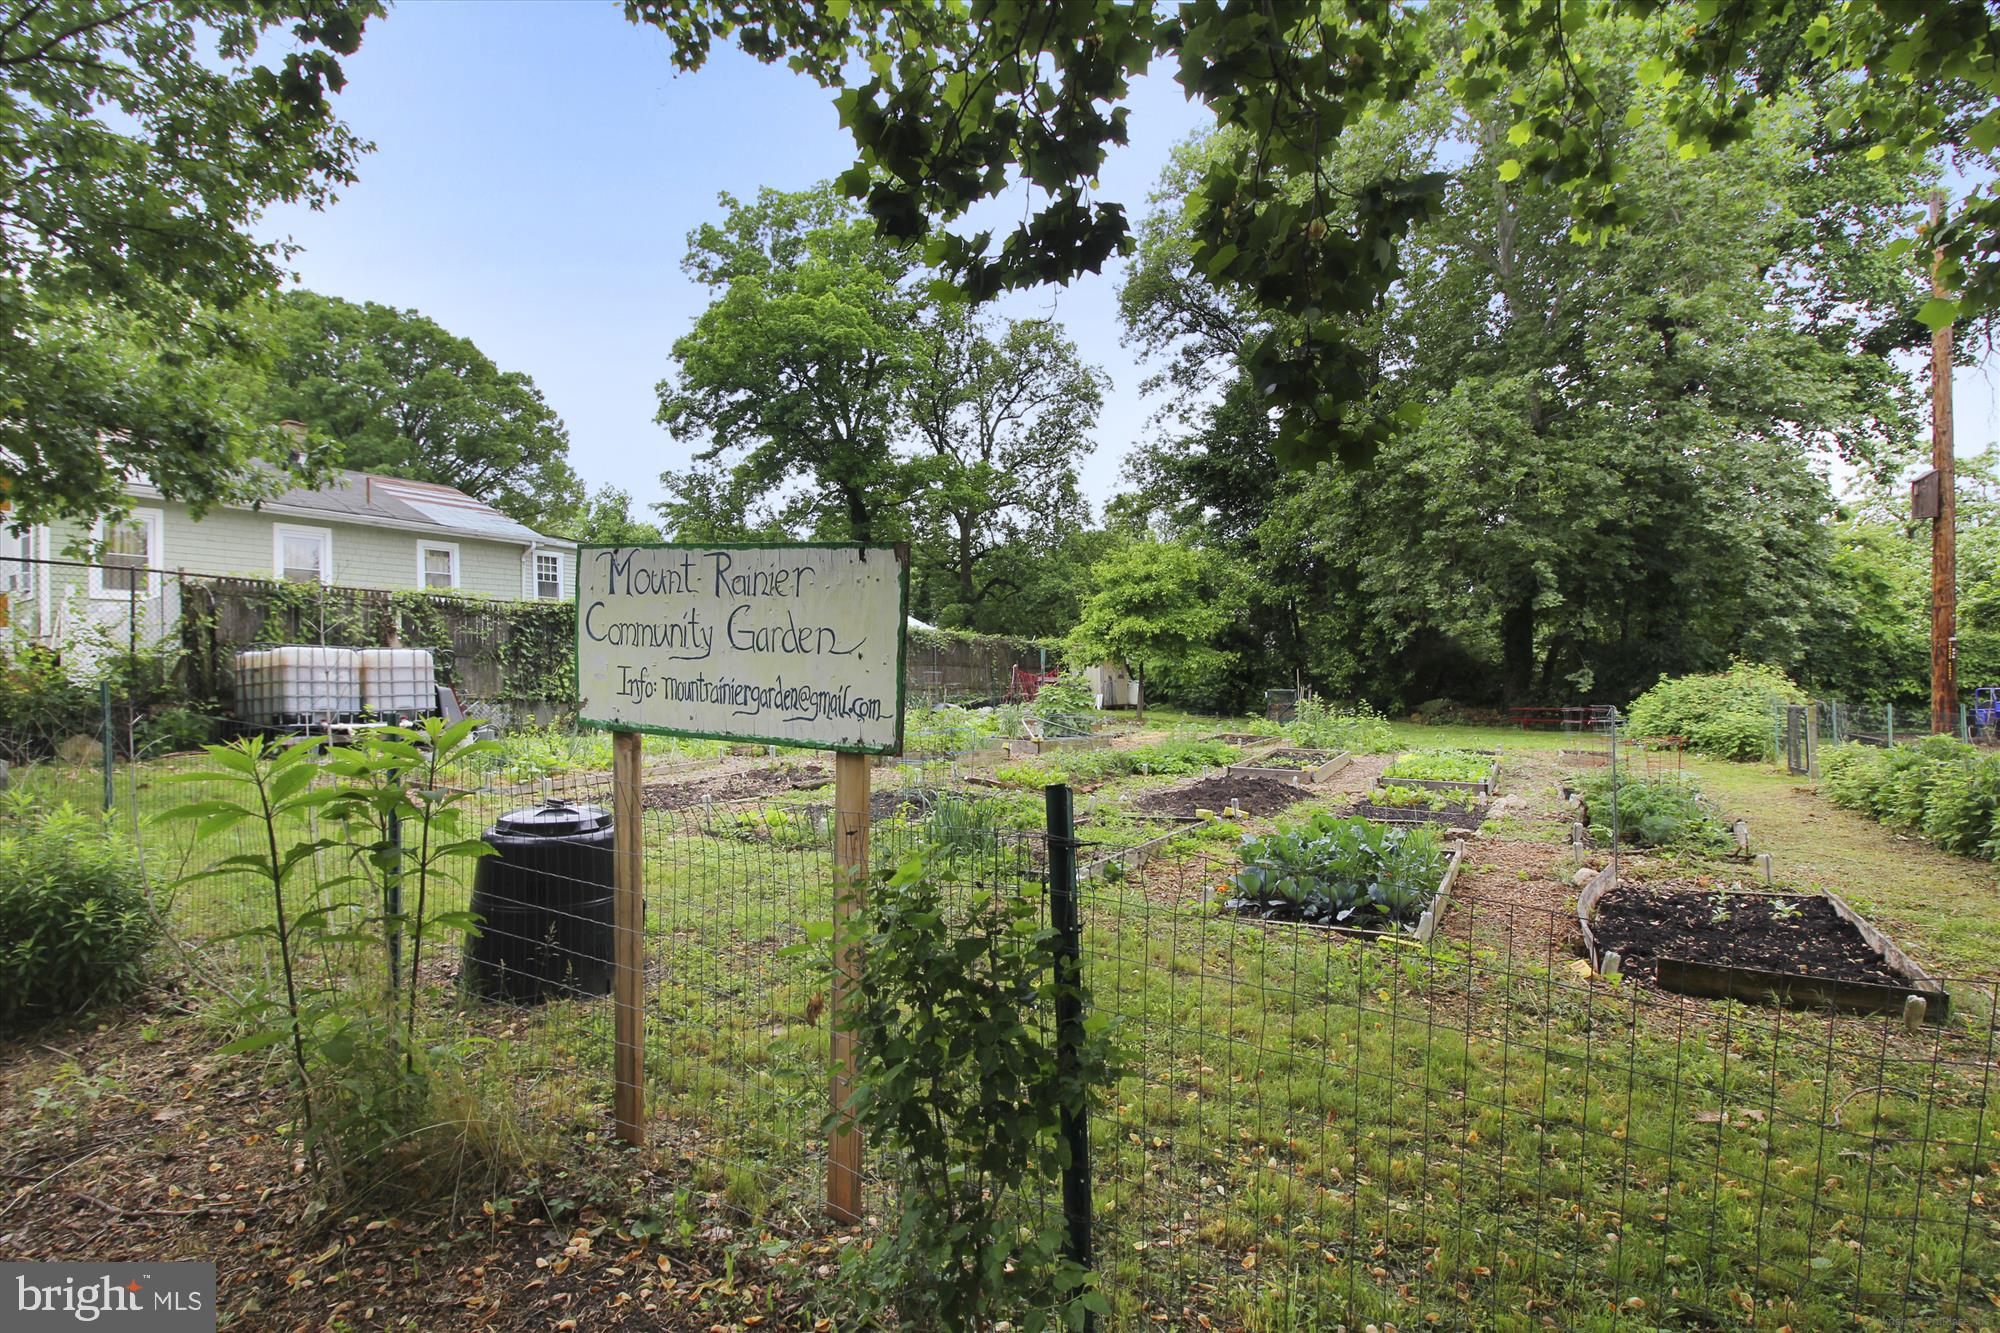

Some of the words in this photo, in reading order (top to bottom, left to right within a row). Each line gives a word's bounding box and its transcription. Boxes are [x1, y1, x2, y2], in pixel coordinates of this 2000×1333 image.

[595, 548, 699, 597] Mount
[704, 551, 815, 598] Rainier
[585, 601, 713, 660] Community
[727, 604, 867, 654] Garden
[617, 666, 657, 704] Info:
[661, 671, 893, 722] mountrainiergarden@gmail.com
